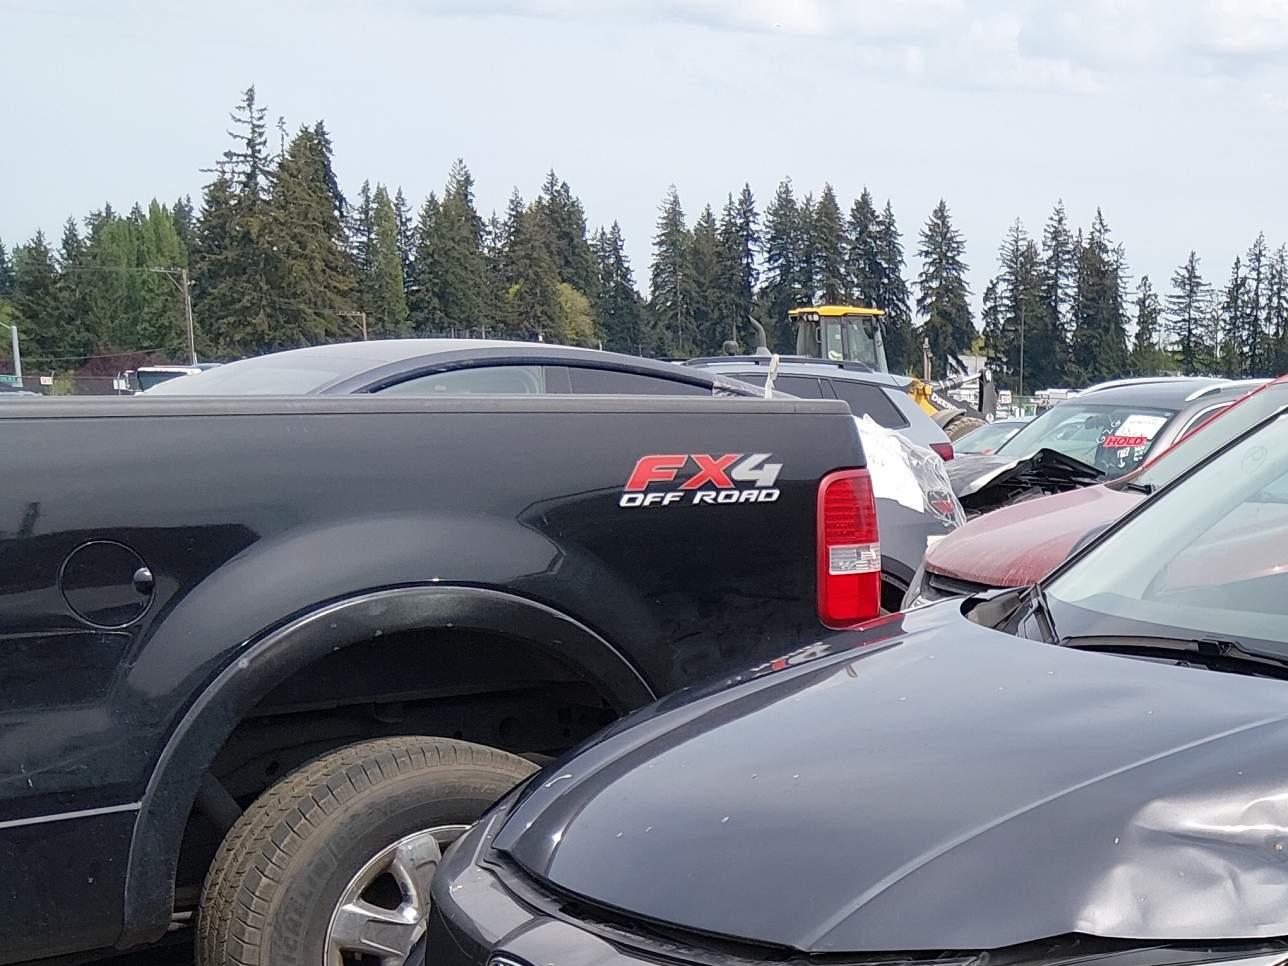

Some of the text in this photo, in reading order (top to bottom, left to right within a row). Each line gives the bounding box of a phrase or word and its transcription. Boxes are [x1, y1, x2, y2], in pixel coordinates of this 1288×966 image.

[1107, 437, 1144, 446] HOLD
[624, 453, 784, 492] FX4
[619, 488, 780, 507] OFF ROAD
